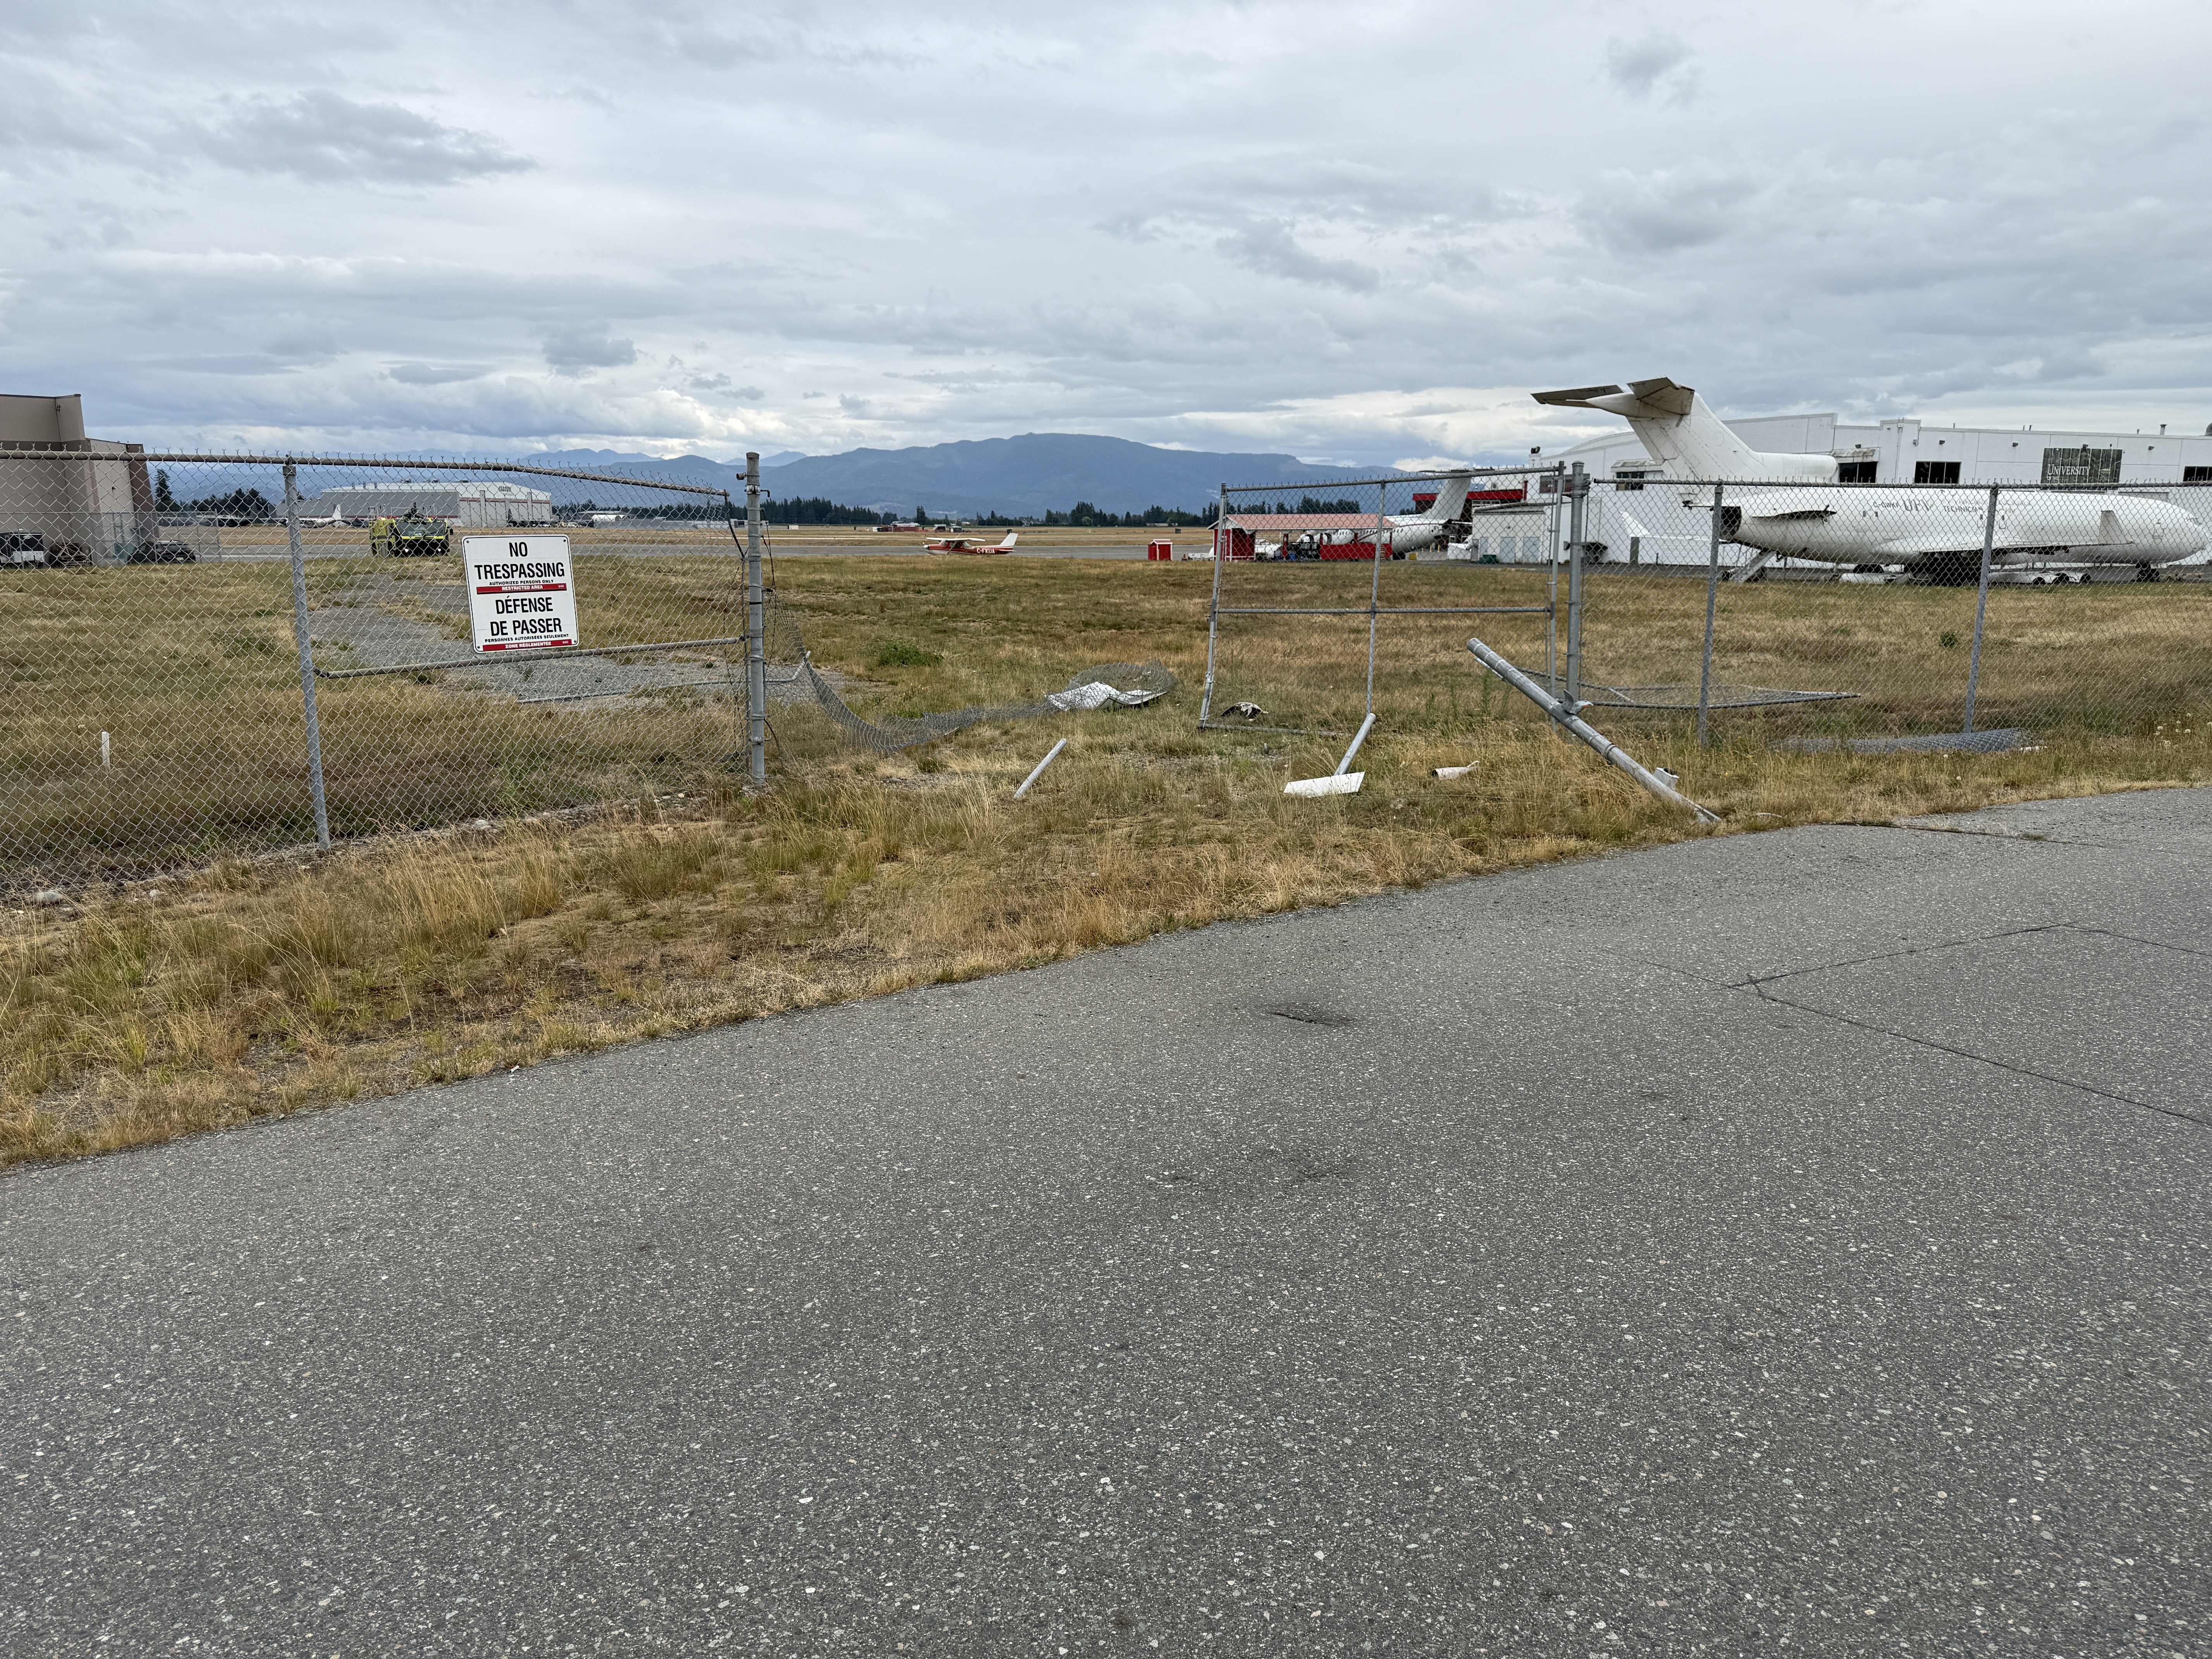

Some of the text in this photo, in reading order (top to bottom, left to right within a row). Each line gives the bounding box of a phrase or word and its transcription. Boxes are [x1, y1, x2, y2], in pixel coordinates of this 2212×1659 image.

[2048, 464, 2090, 475] UNIVERSITY
[509, 542, 528, 557] NO
[474, 562, 565, 580] TRESPASSING
[495, 595, 553, 614] DÉFENSE
[490, 618, 562, 636] DE PASSER
